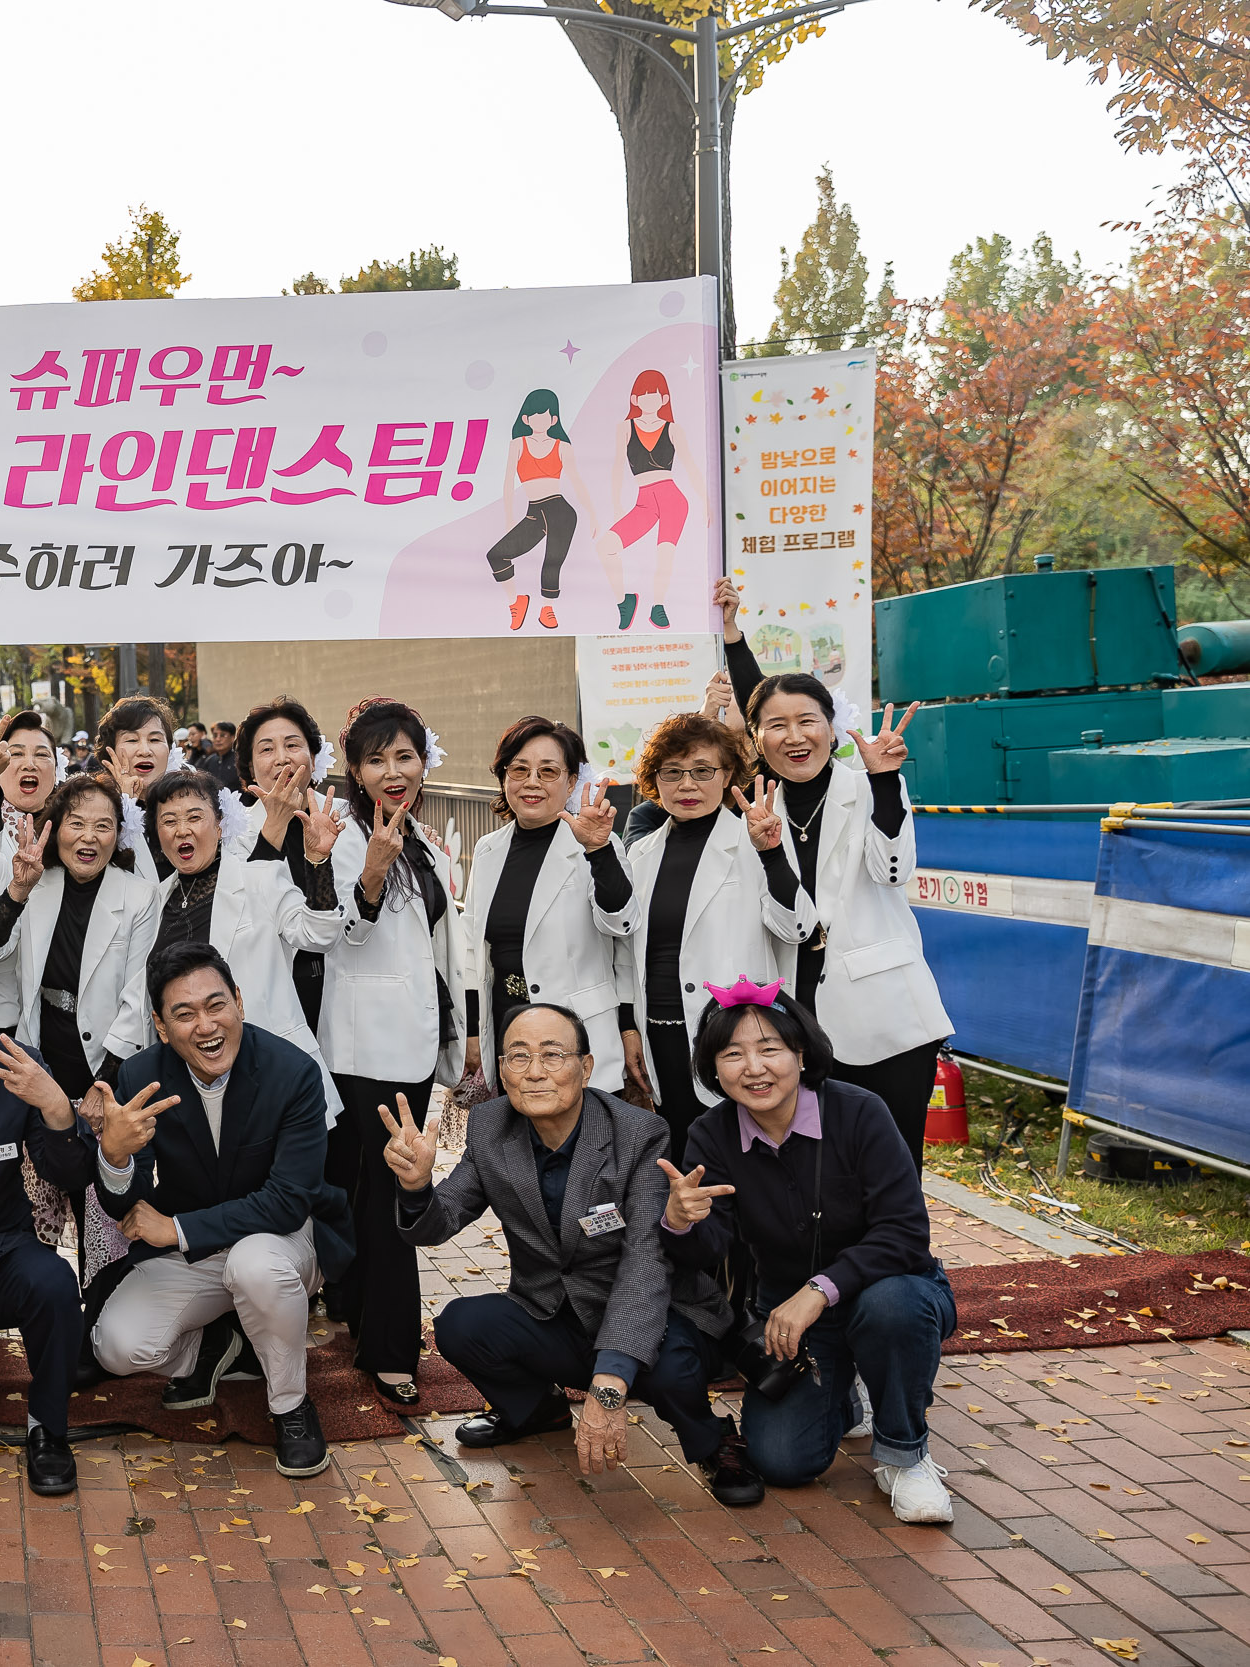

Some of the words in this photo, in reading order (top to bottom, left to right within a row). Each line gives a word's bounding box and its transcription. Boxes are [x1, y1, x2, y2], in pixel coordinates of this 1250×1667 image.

[10, 344, 305, 411] 슈퍼우먼~
[3, 418, 489, 512] 라인댄스팀!
[760, 446, 836, 470] 밤낮으로
[760, 475, 836, 497] 이어지는
[769, 504, 827, 524] 다양한
[742, 535, 776, 554] 체험
[783, 530, 855, 552] 프로그램
[154, 542, 354, 588] 가즈아~
[917, 876, 941, 901] 전기
[963, 881, 988, 906] 위험
